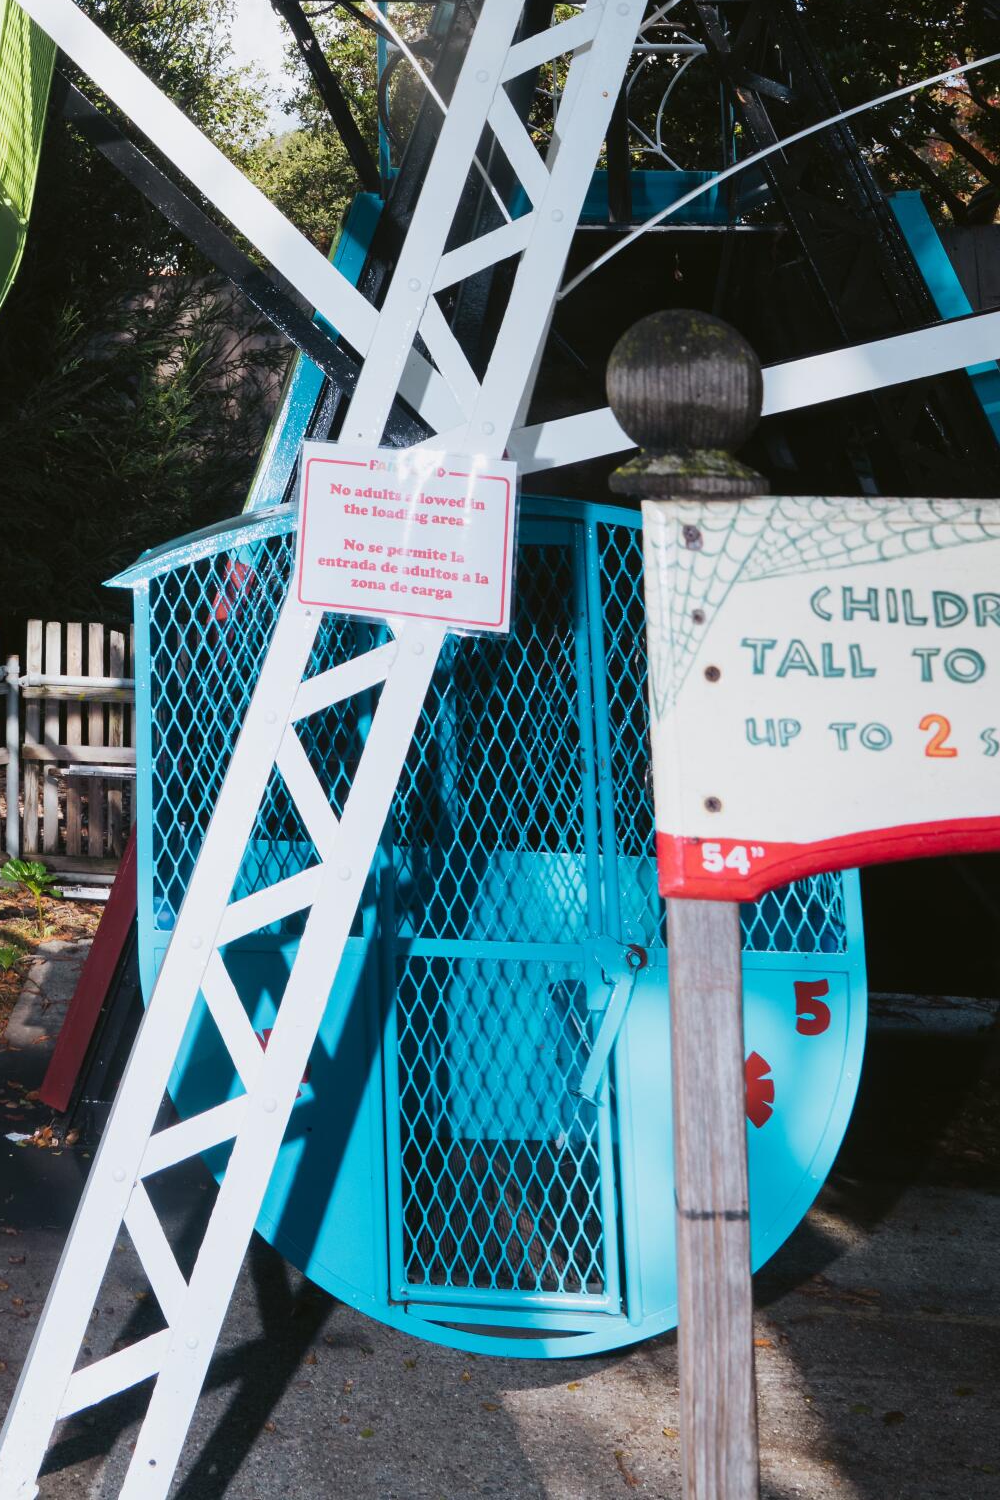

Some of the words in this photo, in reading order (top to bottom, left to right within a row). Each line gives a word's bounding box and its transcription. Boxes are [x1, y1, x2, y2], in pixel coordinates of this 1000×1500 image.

[329, 483, 351, 496] No
[354, 486, 401, 502] adults
[405, 492, 466, 510] alowed
[343, 503, 369, 516] the
[431, 514, 465, 527] area
[343, 538, 365, 552] No
[368, 542, 383, 554] se
[386, 543, 448, 561] permite
[451, 550, 465, 564] la
[317, 556, 377, 572] entrada
[380, 561, 399, 574] de
[402, 564, 459, 582] adultos
[462, 573, 471, 583] a
[475, 572, 490, 585] la
[350, 578, 386, 592] zona
[389, 580, 408, 593] de
[411, 585, 454, 601] carga
[810, 586, 1000, 628] CHILDR
[741, 637, 877, 679] TALL
[911, 647, 986, 684] TO
[744, 717, 801, 747] UP
[828, 722, 893, 751] TO
[918, 713, 959, 758] 2
[793, 978, 831, 1036] 5
